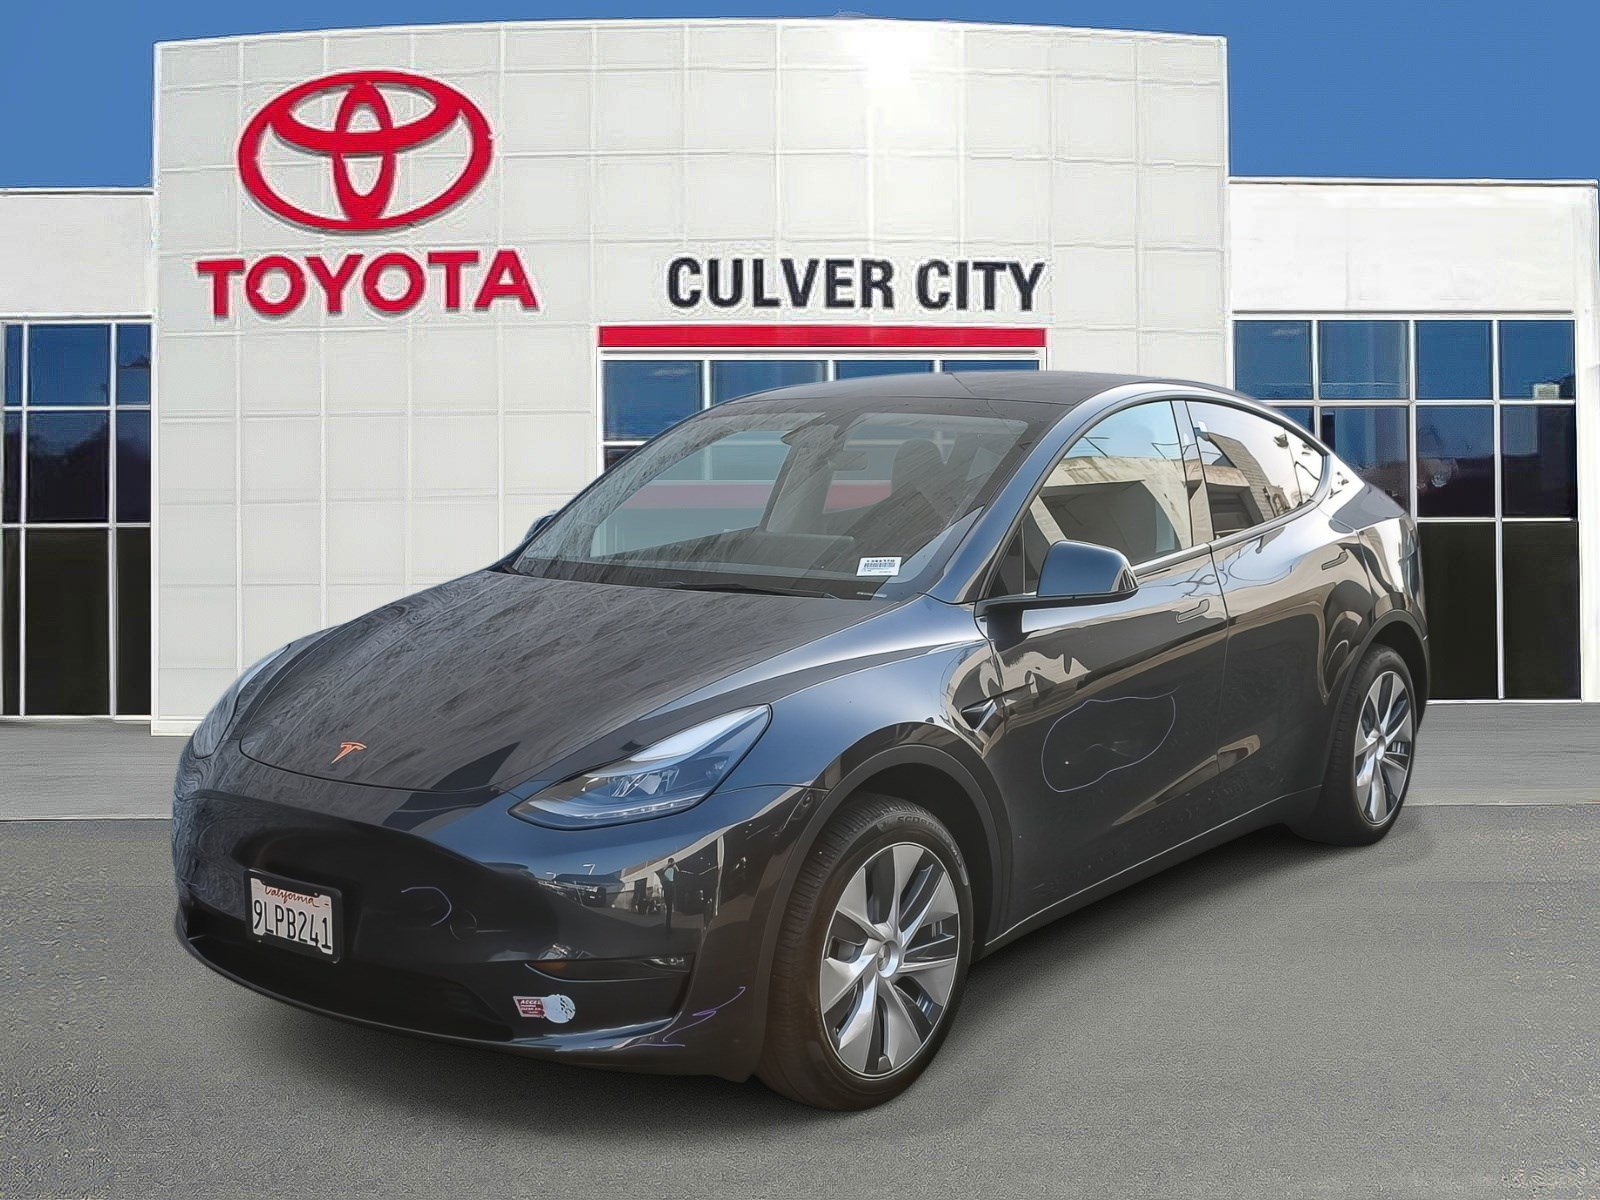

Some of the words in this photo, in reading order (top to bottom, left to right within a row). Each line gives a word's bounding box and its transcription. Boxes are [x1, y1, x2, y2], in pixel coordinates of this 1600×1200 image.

[196, 249, 538, 317] TOYOTA
[667, 257, 894, 308] CULVER
[916, 258, 1045, 311] CITY
[254, 900, 331, 950] 9LPB241
